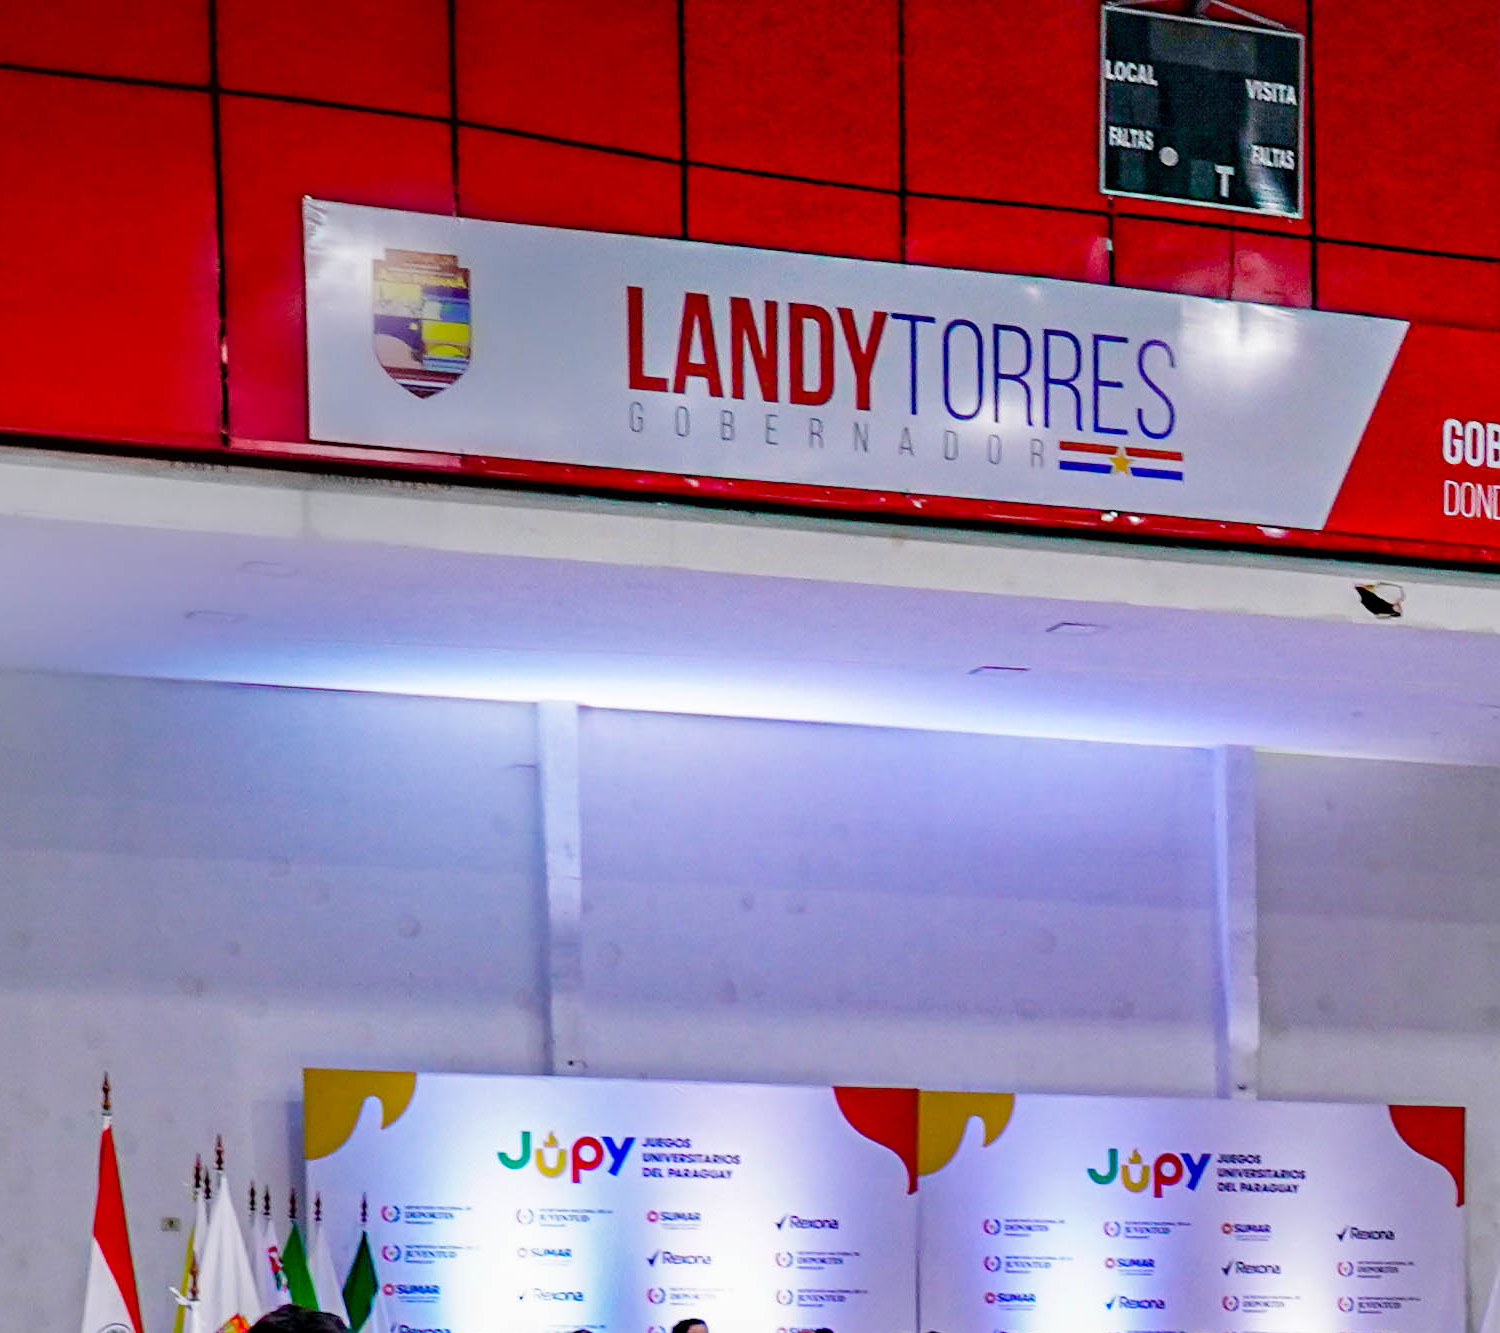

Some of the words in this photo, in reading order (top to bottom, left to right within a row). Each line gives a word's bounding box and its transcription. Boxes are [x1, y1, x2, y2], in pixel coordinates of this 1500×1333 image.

[1104, 59, 1158, 86] LOCAL
[1245, 78, 1297, 106] VISITA
[1109, 125, 1154, 150] FALTAS
[629, 402, 1045, 468] GOBERNADOR
[642, 1137, 692, 1148] JUEGOS
[642, 1152, 741, 1165] UNIVERSITARIOS
[1216, 1153, 1262, 1164] JUEGOS
[642, 1167, 664, 1178] DEL
[667, 1168, 733, 1179] PARAGUAY
[1216, 1168, 1306, 1180] UNIVERSITARIOS
[1216, 1182, 1238, 1192] DEL
[1240, 1182, 1298, 1194] PARAGUAY
[789, 1215, 839, 1230] Rexona
[1233, 1223, 1272, 1233] SUMAR
[1350, 1227, 1395, 1240] Rexona
[662, 1251, 711, 1265] Rexona
[1235, 1261, 1281, 1274] Rexona
[396, 1284, 441, 1294] SUMAR
[1119, 1296, 1166, 1310] Rexona
